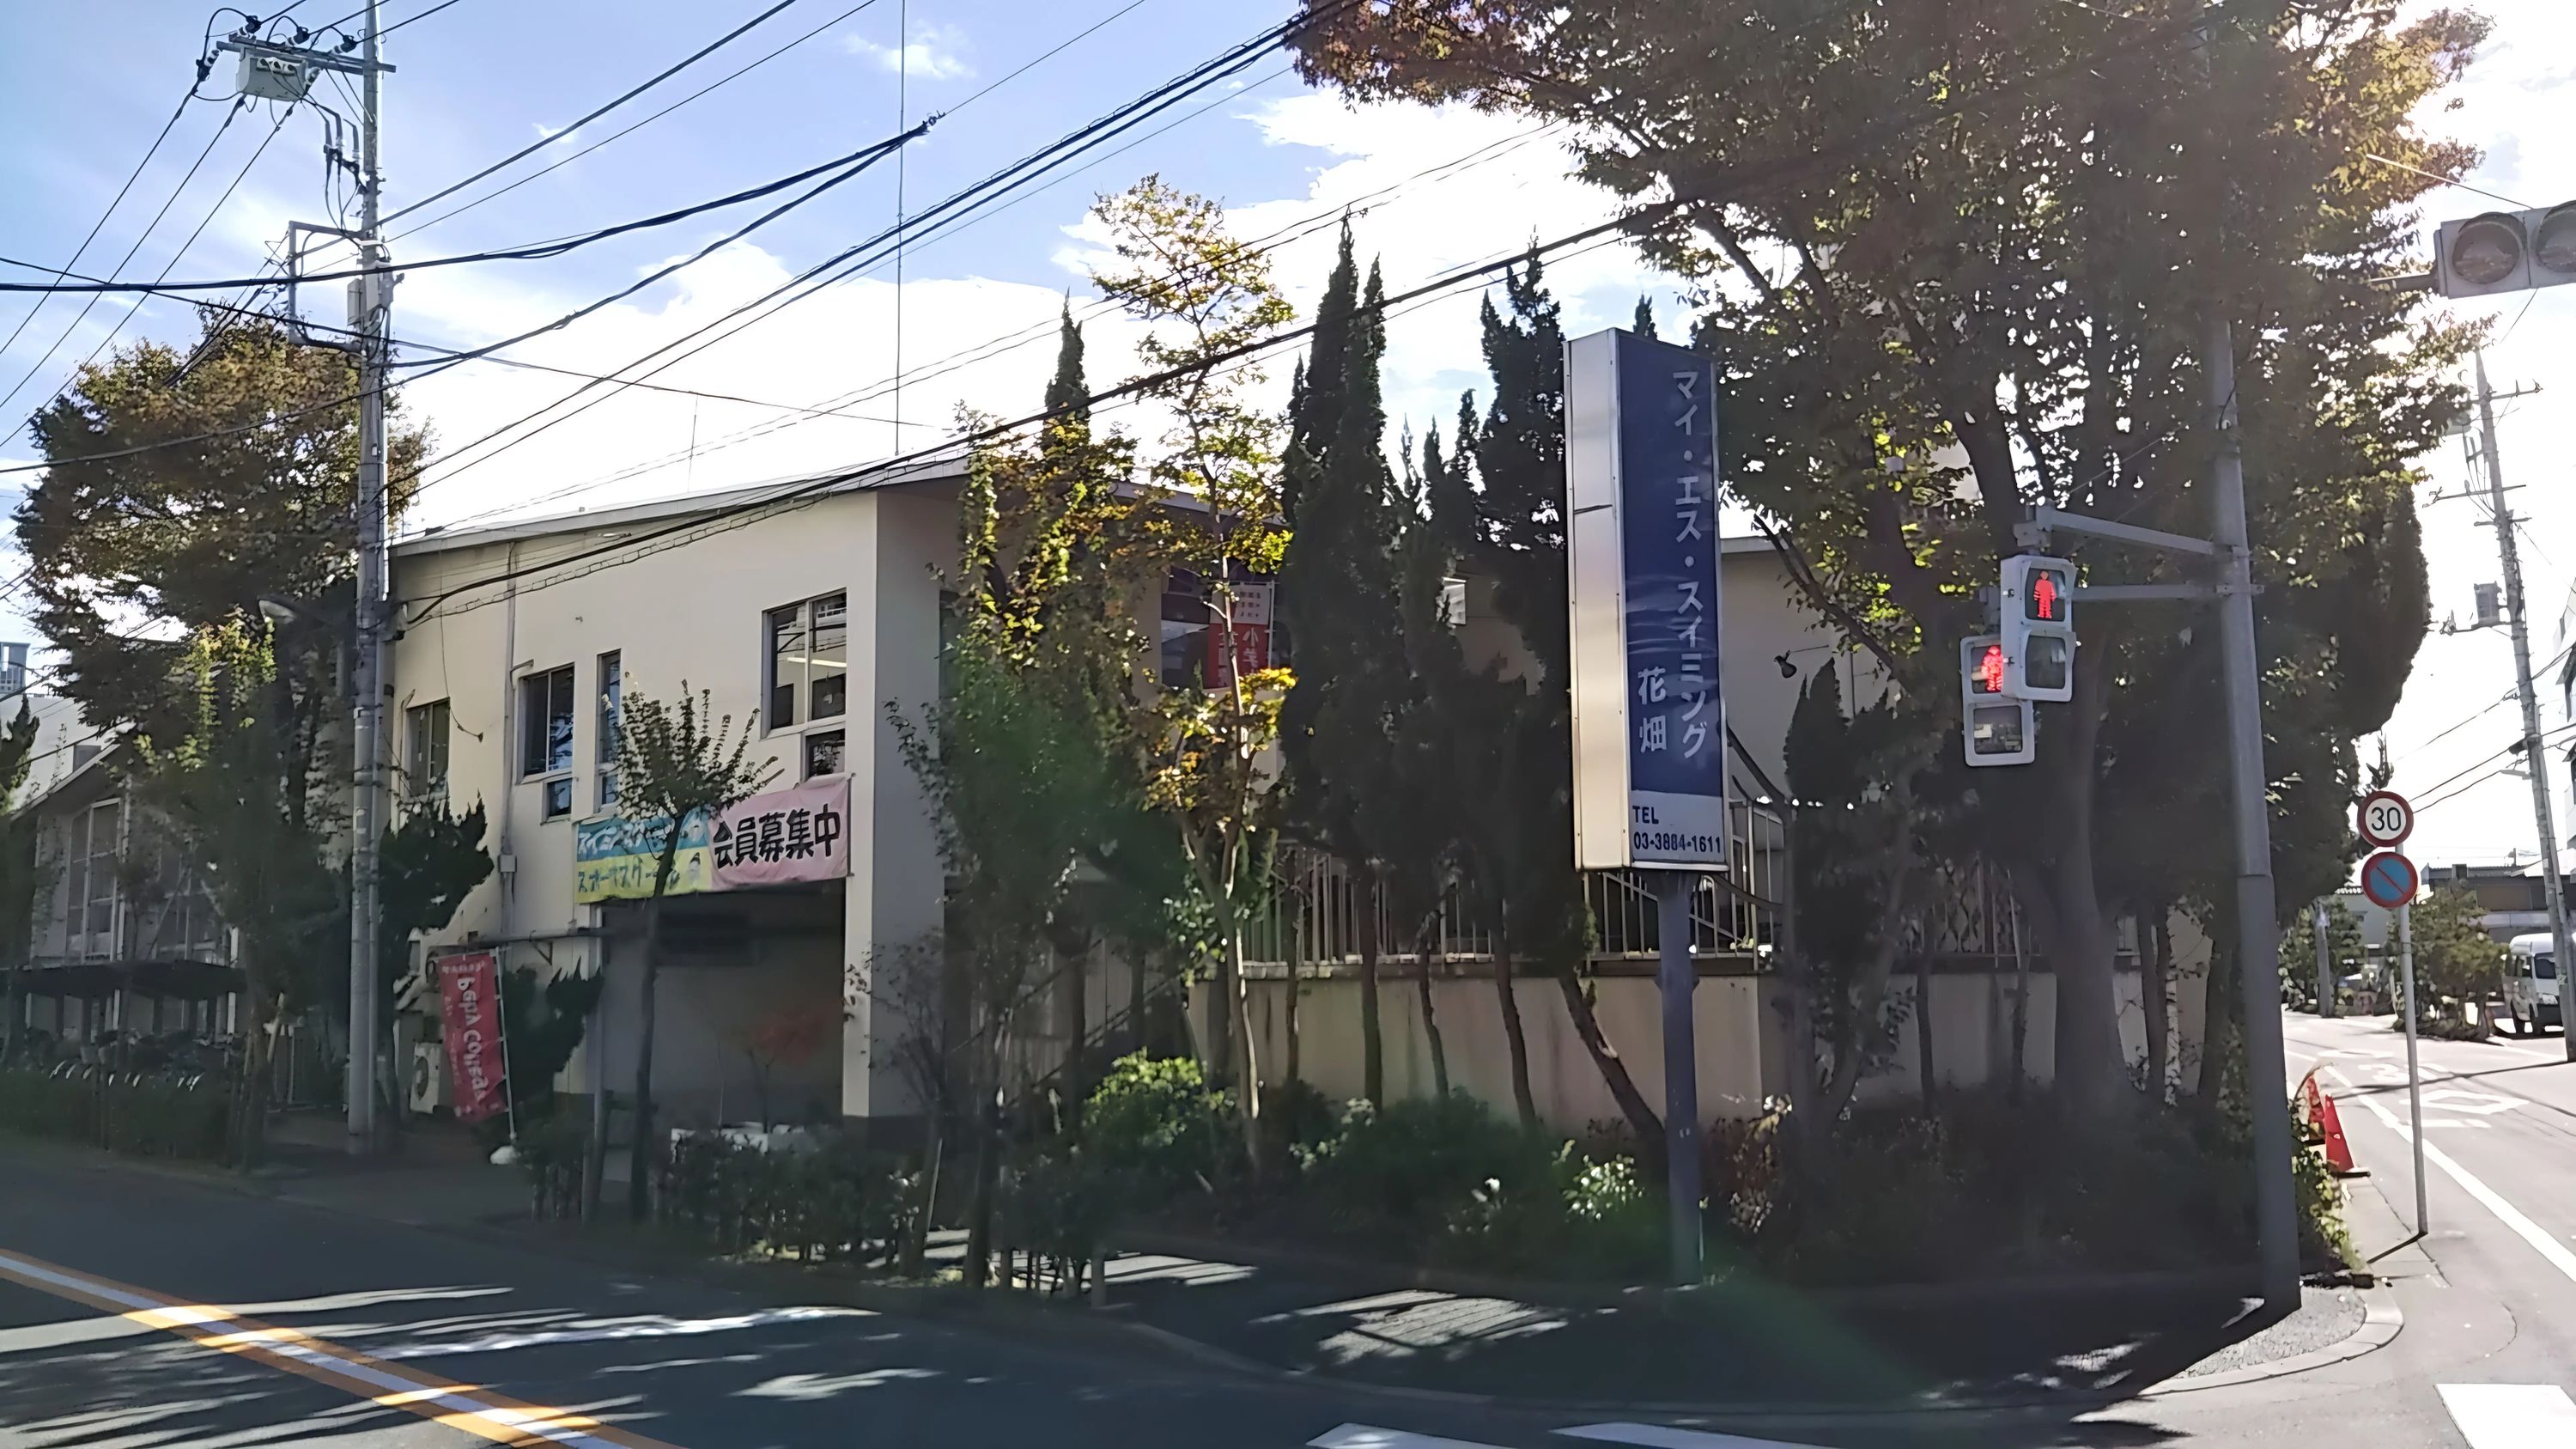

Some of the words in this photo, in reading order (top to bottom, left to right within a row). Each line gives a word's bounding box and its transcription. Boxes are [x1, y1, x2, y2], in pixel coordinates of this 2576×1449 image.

[1673, 371, 1708, 759] マイ・エス・スイミング
[1637, 666, 1668, 753] 花畑
[712, 803, 841, 870] 会員募集中
[1631, 805, 1660, 825] TEL
[2371, 806, 2402, 831] 30
